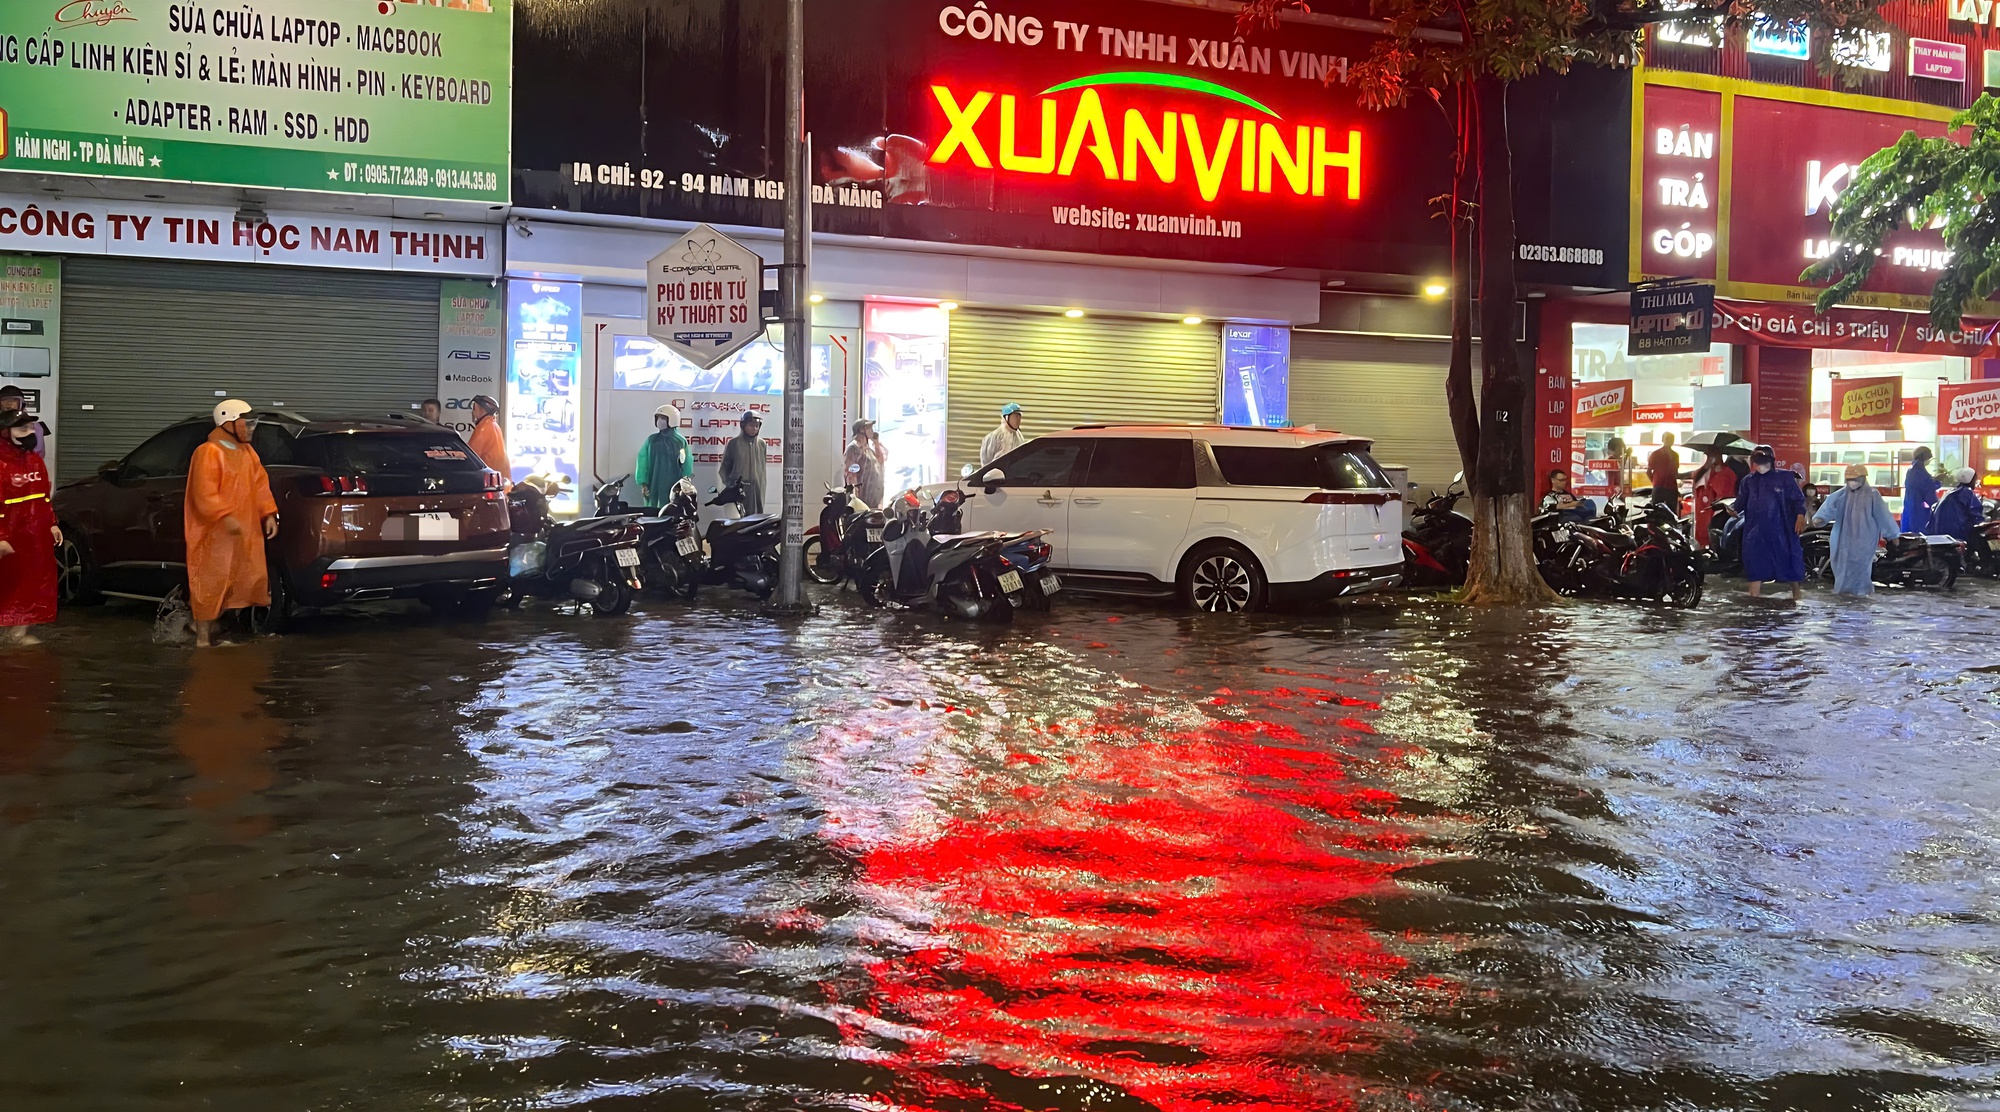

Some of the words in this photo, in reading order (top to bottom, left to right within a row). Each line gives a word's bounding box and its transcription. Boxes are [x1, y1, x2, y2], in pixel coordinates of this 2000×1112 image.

[169, 0, 206, 34] SỬA
[213, 4, 264, 40] CHỮA
[271, 15, 341, 47] LAPTOP
[357, 25, 442, 57] MACBOOK
[938, 1, 1044, 46] CÔNG
[1053, 20, 1090, 52] TY
[1098, 26, 1177, 63] TNHH
[1187, 36, 1271, 75] XUÂN
[1279, 50, 1348, 83] VINH
[1914, 46, 1932, 56] THAY
[25, 27, 64, 66] CẤP
[71, 42, 115, 71] LINH
[123, 42, 168, 83] KIỆN
[199, 54, 211, 81] &
[252, 53, 291, 88] MÀN
[298, 57, 341, 93] HÌNH
[357, 69, 385, 96] PIN
[401, 73, 491, 105] KEYBOARD
[1925, 63, 1953, 74] LAPTOP
[125, 98, 211, 131] ADAPTER
[229, 107, 268, 136] RAM
[284, 112, 318, 140] SSD
[334, 116, 369, 143] HDD
[15, 131, 40, 159] HÀM
[43, 138, 71, 161] NGHI
[79, 141, 93, 163] TP
[96, 138, 111, 164] ĐÀ
[113, 135, 145, 167] NẴNG
[1656, 123, 1713, 159] BÁN
[364, 163, 428, 187] 0905.77.23.89
[435, 169, 497, 191] 0913.44.35.88
[597, 162, 635, 187] CHỈ:
[640, 169, 664, 190] 92
[682, 172, 705, 194] 94
[710, 173, 749, 197] HÀM
[811, 183, 834, 206] ĐÀ
[839, 182, 883, 209] NẴNG
[1659, 172, 1708, 209] TRẢ
[1052, 204, 1130, 230] website:
[1135, 213, 1242, 238] xuanvinh.vn
[0, 204, 95, 239] CÔNG
[107, 214, 152, 241] TY
[163, 217, 219, 245] TIN
[233, 218, 300, 255] HỌC
[311, 226, 379, 254] NAM
[390, 231, 484, 263] THỊNH
[1653, 222, 1713, 259] GÓP
[1893, 246, 1931, 272] PHỤ
[657, 278, 686, 302] PHỐ
[690, 280, 722, 302] ĐIỆN
[727, 276, 748, 300] TỬ
[1641, 294, 1664, 309] THU
[1666, 292, 1694, 307] MUA
[657, 304, 675, 325] KỸ
[680, 303, 725, 326] THUẬT
[730, 299, 748, 324] SỐ
[1630, 312, 1682, 334] LAPTOP
[1711, 313, 1734, 329] OP
[1767, 314, 1797, 334] GIÁ
[1802, 316, 1830, 336] CHỈ
[1835, 323, 1845, 336] 3
[1850, 321, 1889, 342] TRIỆU
[1916, 323, 1946, 343] SỬA
[1229, 328, 1252, 338] Lexar
[1638, 338, 1651, 348] 88
[447, 350, 491, 360] ASUS
[452, 374, 493, 383] MacBook
[1548, 374, 1566, 389] BÁN
[445, 398, 475, 410] ac
[749, 404, 770, 412] PC
[1548, 401, 1565, 414] LAP
[1581, 396, 1598, 411] TRẢ
[1600, 392, 1619, 406] GÓP
[1848, 398, 1891, 416] LAPTOP
[1955, 397, 1974, 408] THU
[1976, 393, 1998, 404] MUA
[1636, 411, 1664, 420] Lenovo
[1673, 411, 1693, 419] LEGIO
[1955, 402, 2000, 420] LAPTOP
[445, 422, 476, 432] SON
[700, 418, 741, 428] LAPT
[1548, 425, 1565, 438] TOP
